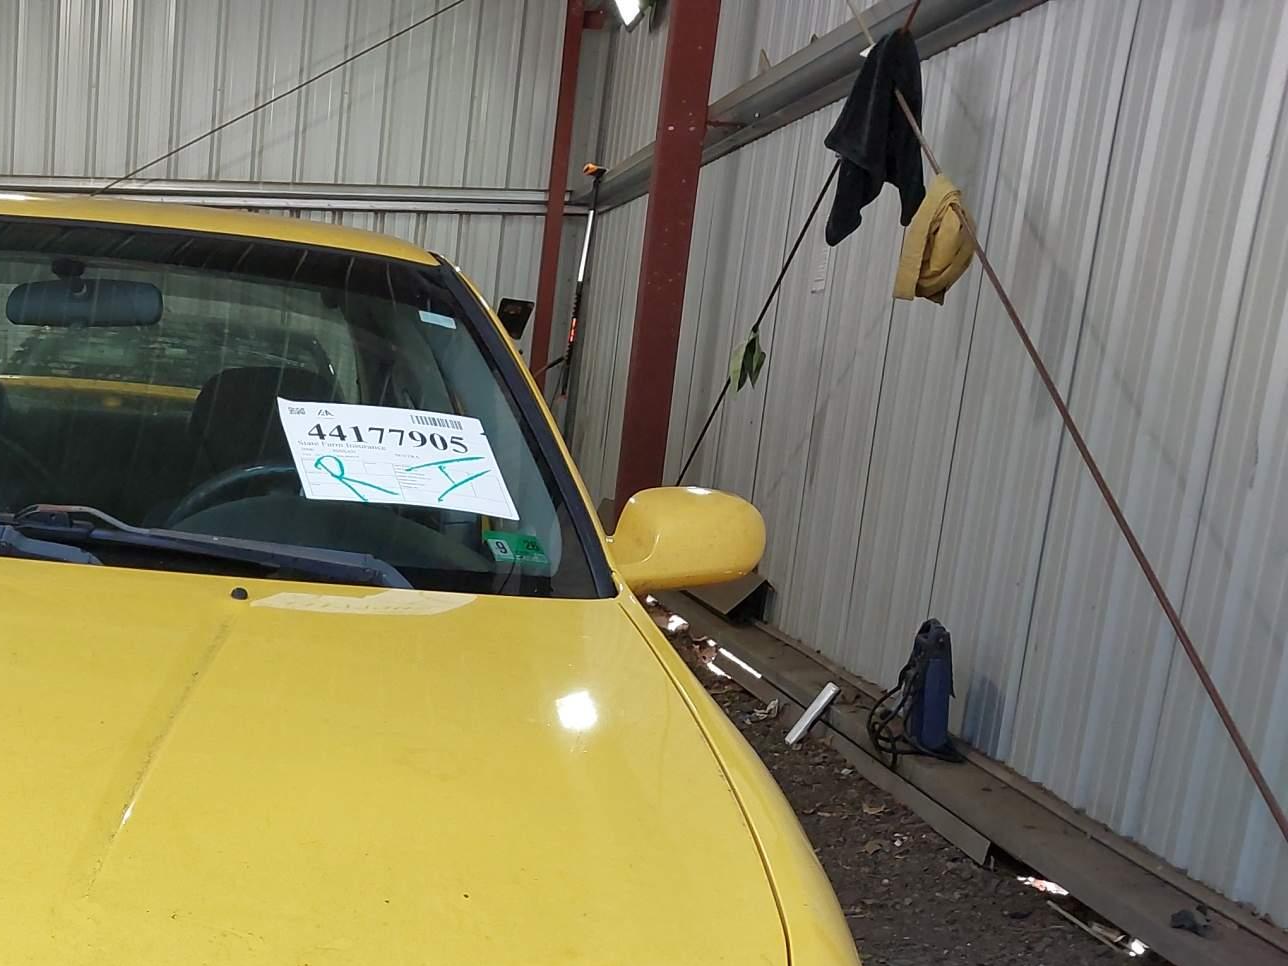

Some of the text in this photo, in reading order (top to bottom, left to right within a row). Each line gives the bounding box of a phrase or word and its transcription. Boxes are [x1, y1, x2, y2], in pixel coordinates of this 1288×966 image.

[307, 423, 469, 454] 44177905
[346, 442, 387, 451] Insurance
[495, 541, 508, 554] 9
